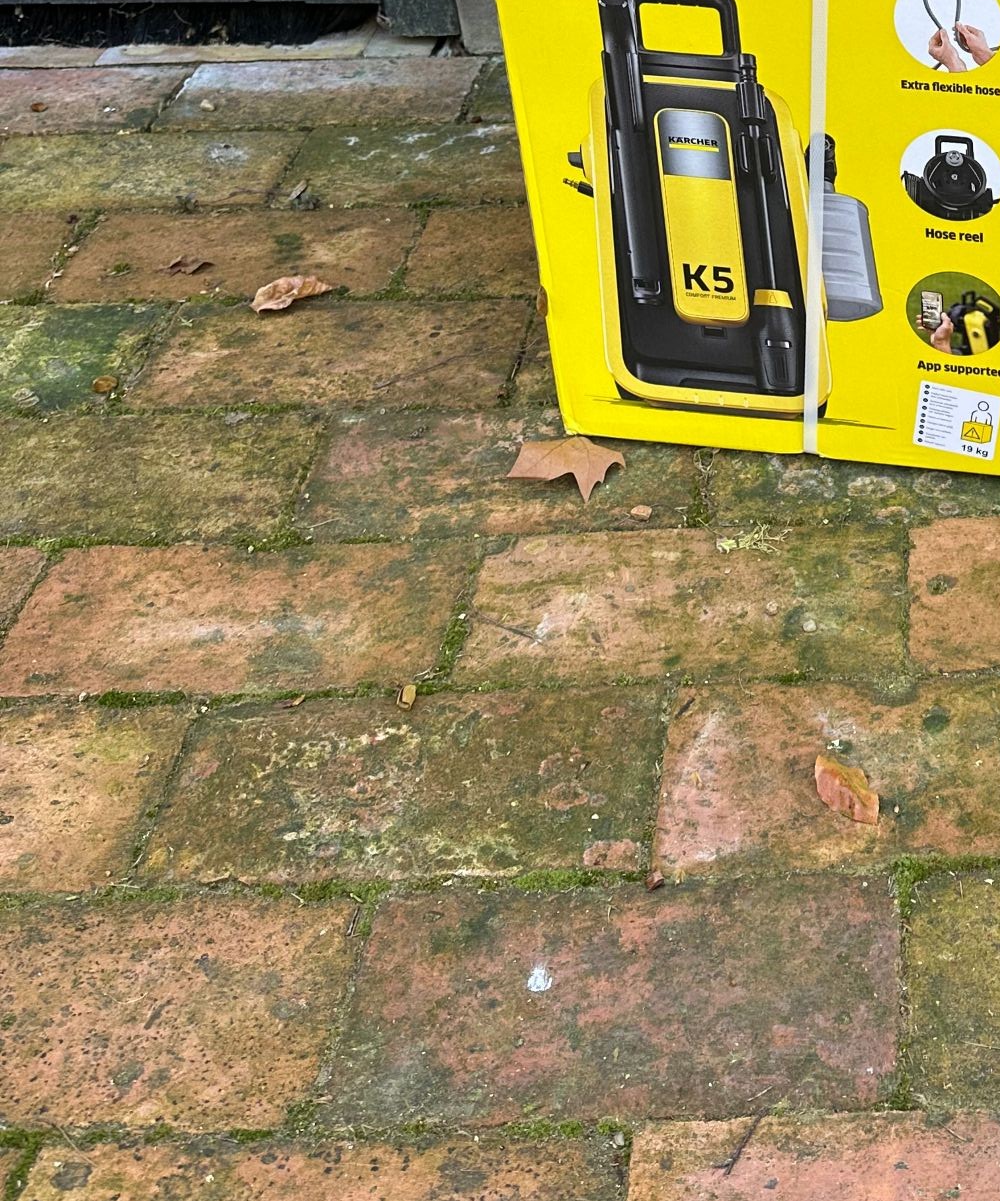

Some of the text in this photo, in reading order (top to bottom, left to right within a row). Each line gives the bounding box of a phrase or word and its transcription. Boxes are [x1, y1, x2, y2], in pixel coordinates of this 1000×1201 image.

[901, 79, 1000, 96] Extra flexible hose
[668, 136, 718, 147] KÄRCHER
[925, 228, 984, 243] Hose reel
[682, 263, 734, 294] K5
[917, 360, 942, 373] App
[976, 447, 988, 457] kg
